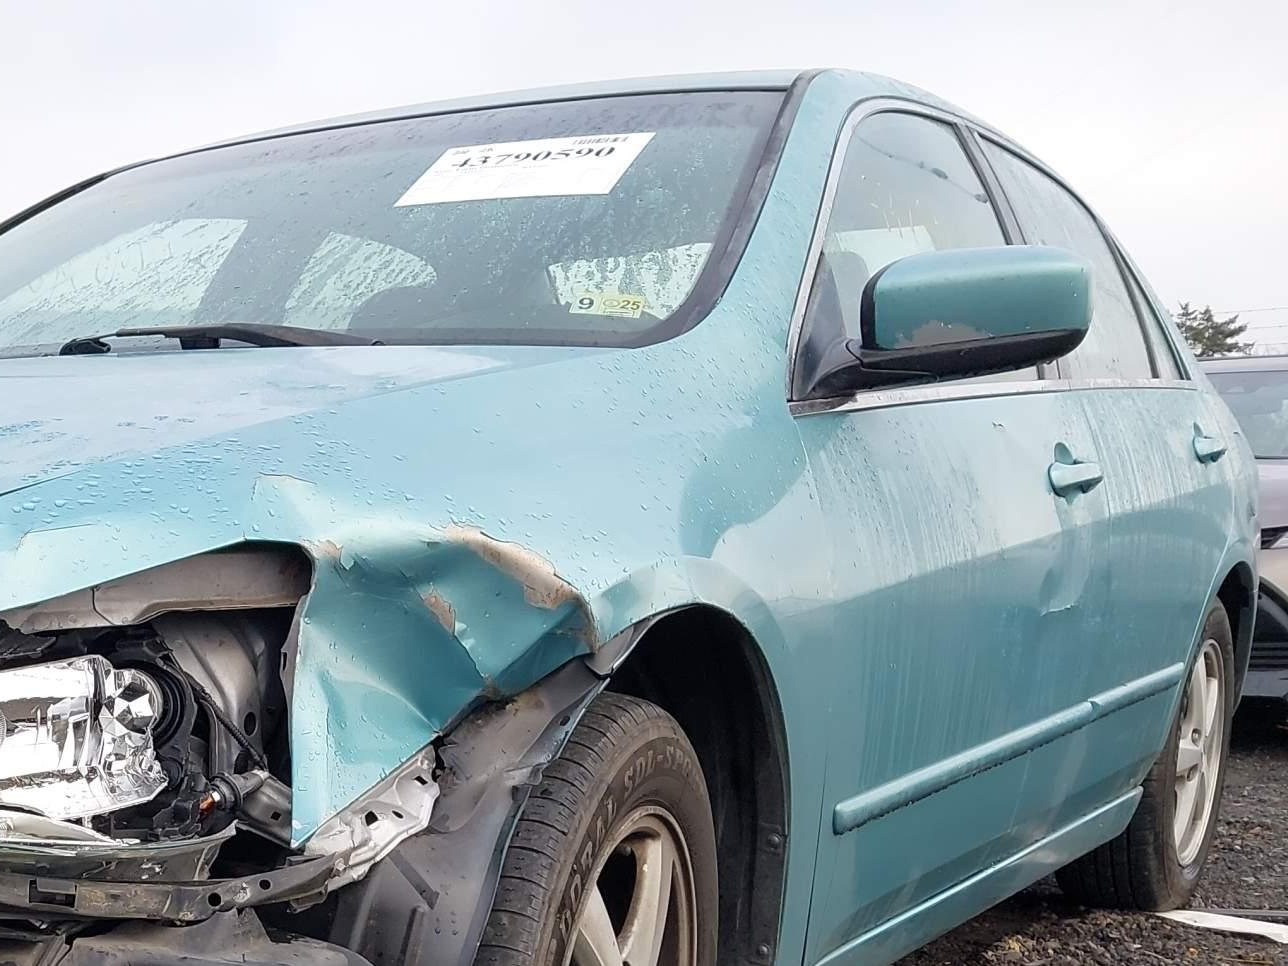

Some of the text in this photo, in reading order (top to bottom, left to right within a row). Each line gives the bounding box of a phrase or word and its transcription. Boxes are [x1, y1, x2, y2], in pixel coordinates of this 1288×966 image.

[452, 147, 616, 167] 43790590
[578, 297, 641, 311] 9 25
[624, 745, 700, 802] SDL-SPO
